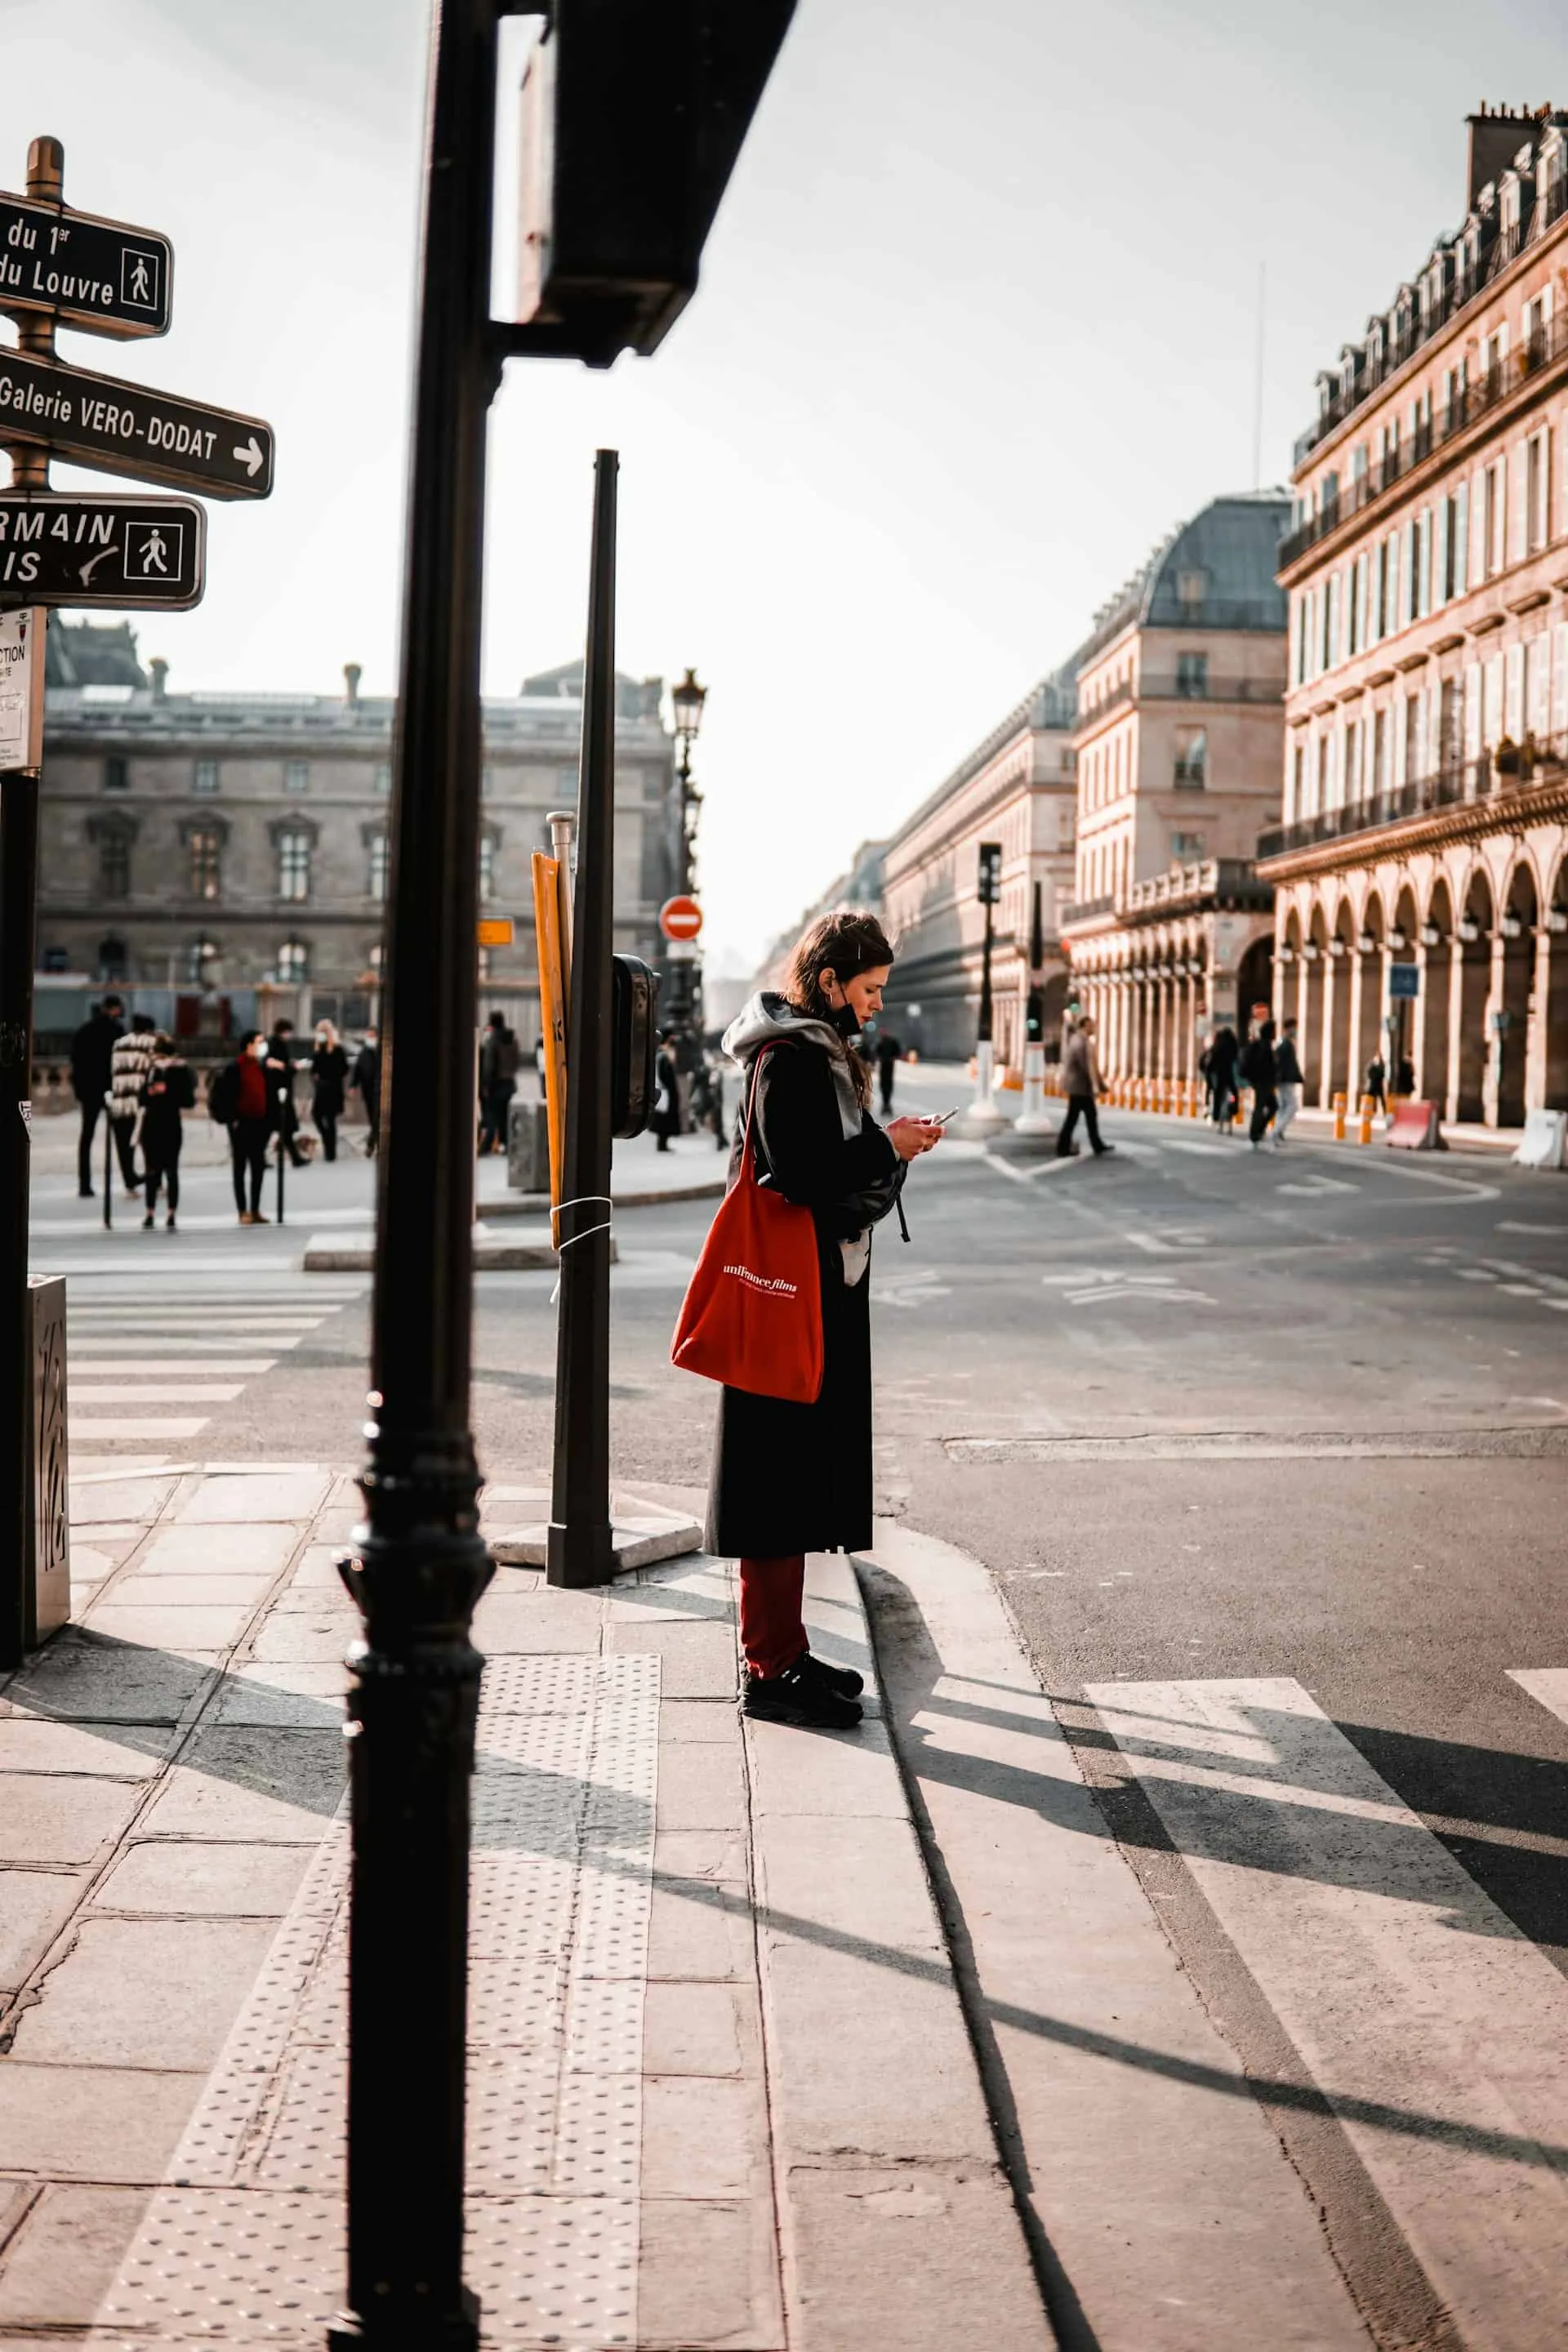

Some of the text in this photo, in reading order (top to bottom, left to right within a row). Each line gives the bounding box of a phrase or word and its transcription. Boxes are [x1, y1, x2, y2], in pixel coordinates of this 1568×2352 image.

[8, 218, 71, 255] du 1er
[0, 253, 114, 305] du Louvre
[0, 376, 217, 460] Galerie VERO-DODAT
[3, 551, 41, 581] IS
[768, 1278, 798, 1292] films
